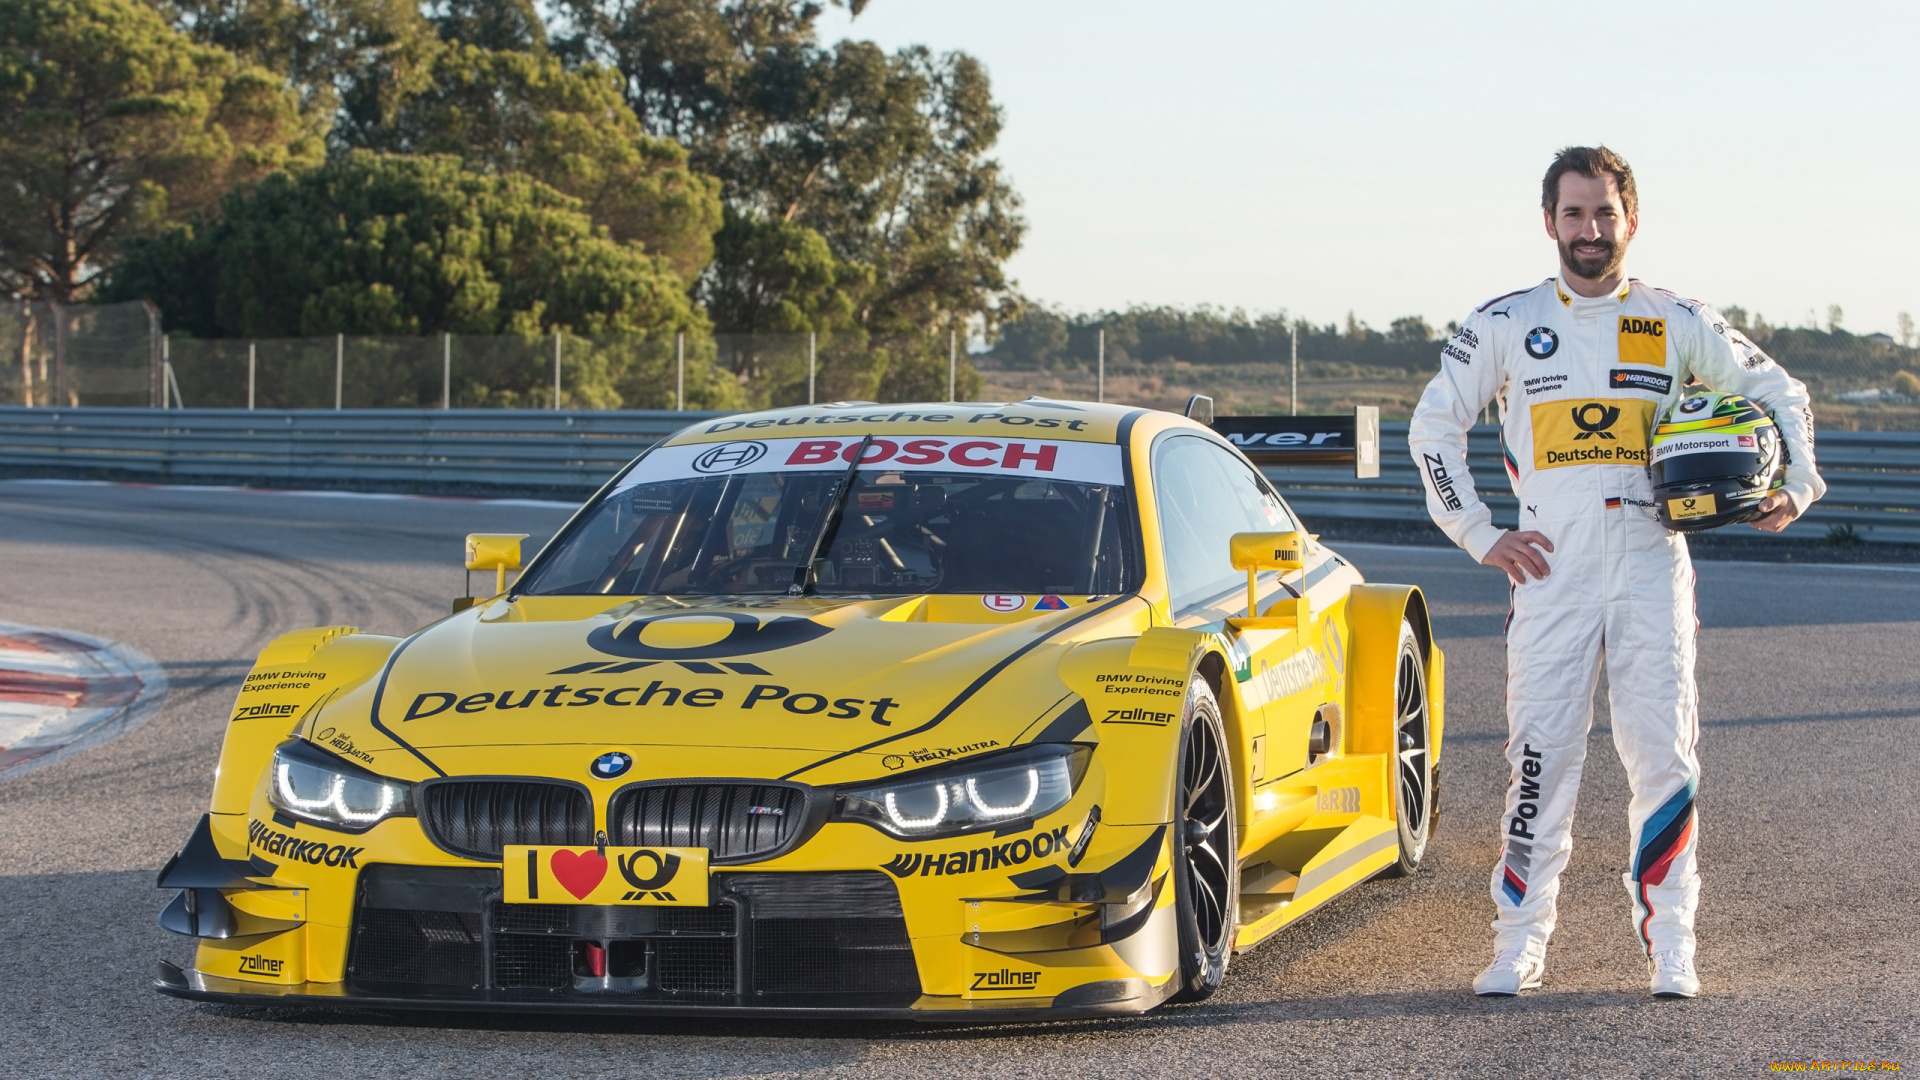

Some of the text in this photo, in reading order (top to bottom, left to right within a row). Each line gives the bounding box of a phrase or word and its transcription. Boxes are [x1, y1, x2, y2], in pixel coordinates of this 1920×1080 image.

[1527, 327, 1556, 339] BMW
[1621, 319, 1663, 337] ADAC
[1524, 374, 1568, 387] BMW Driving
[1526, 383, 1562, 395] Experience
[704, 411, 1089, 435] Deutsche Post
[784, 440, 1059, 472] BOSCH
[1547, 446, 1613, 464] Deutsche
[1616, 447, 1646, 461] Post
[1656, 445, 1673, 457] BMW
[1675, 440, 1730, 452] Motorsport
[994, 593, 1013, 607] E
[247, 671, 327, 682] BMW Driving
[1096, 674, 1184, 688] BMW Driving
[1260, 650, 1313, 702] Deutsche
[1306, 646, 1332, 689] Post
[242, 682, 311, 693] Experience
[1105, 685, 1181, 697] Experience
[402, 680, 901, 727] Deutsche Post
[350, 748, 375, 765] ULTRA
[908, 747, 929, 758] Shell
[912, 739, 1000, 764] HELIX ULTRA
[1509, 743, 1543, 841] Power
[527, 849, 539, 900] I
